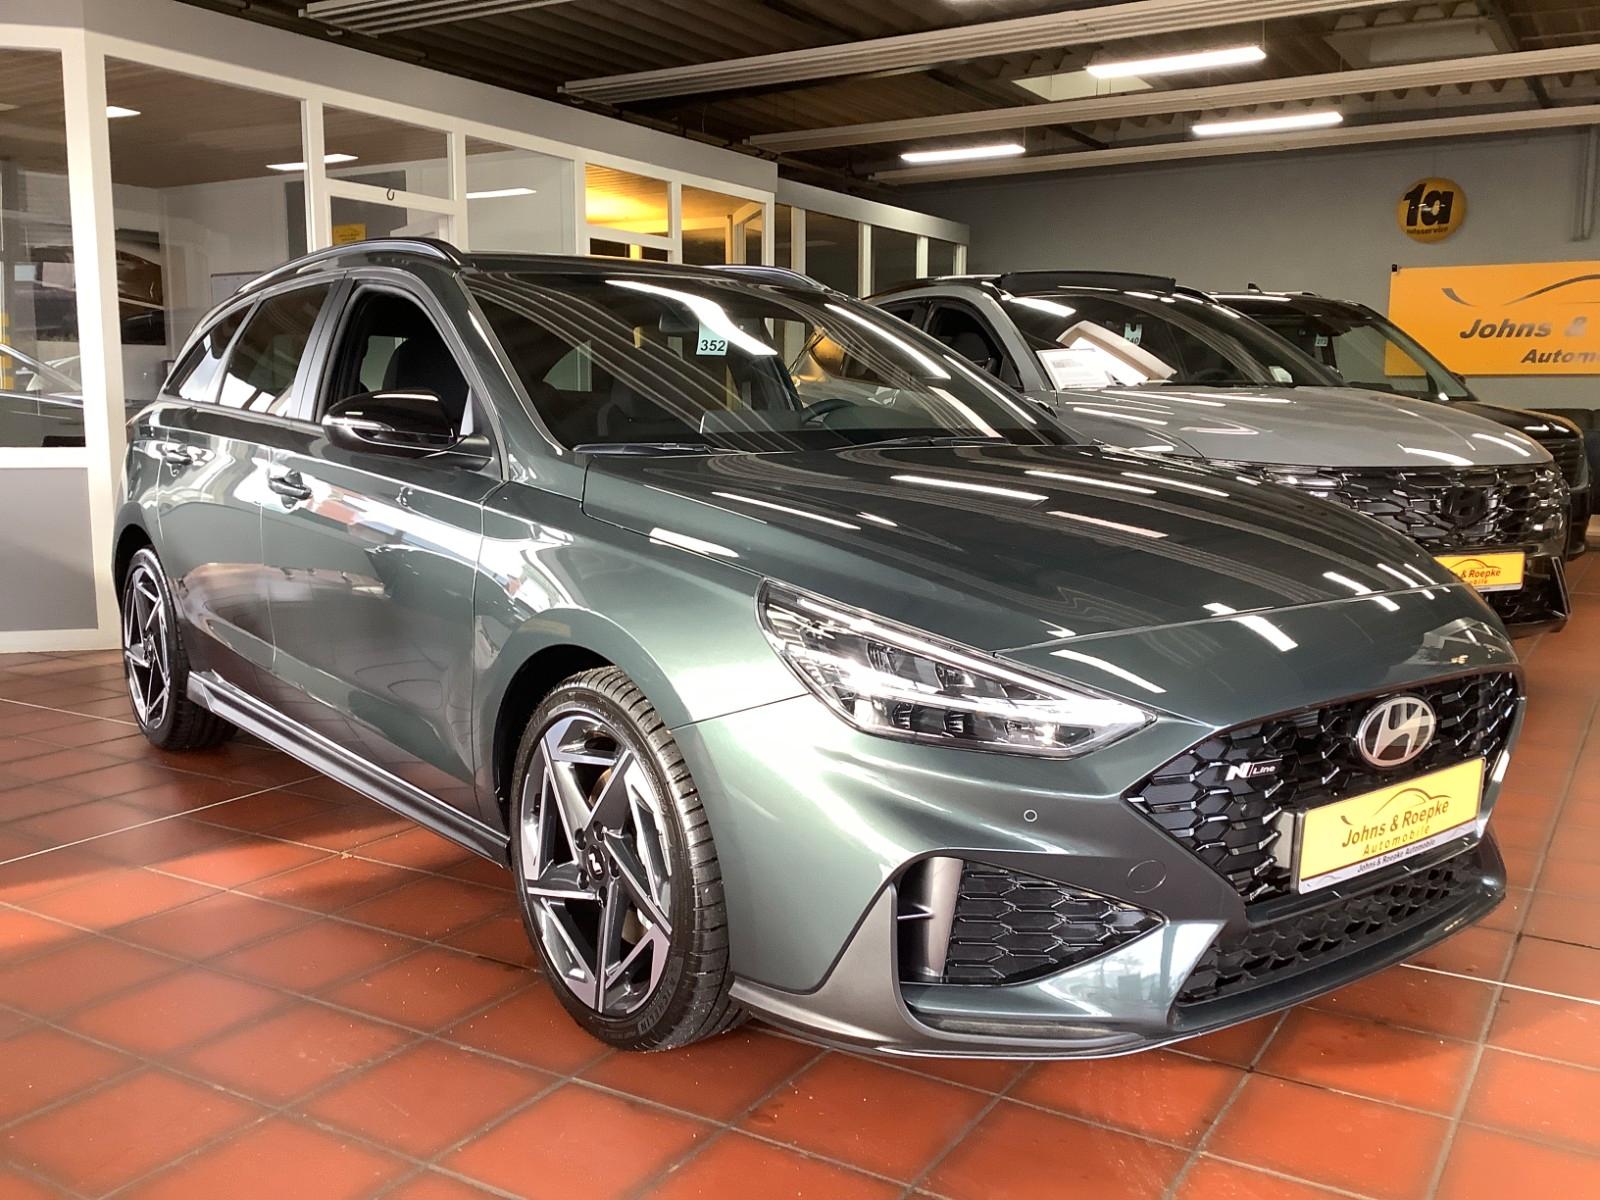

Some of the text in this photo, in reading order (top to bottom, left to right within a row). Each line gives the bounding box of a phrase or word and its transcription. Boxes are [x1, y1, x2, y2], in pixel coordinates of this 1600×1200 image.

[1403, 183, 1454, 226] 1a
[1460, 318, 1552, 339] Johns
[700, 339, 726, 352] 352
[1520, 348, 1600, 364] Autom
[1468, 568, 1501, 579] Roepke
[1342, 800, 1449, 848] Johns & Roepke
[1363, 825, 1430, 856] Automobile
